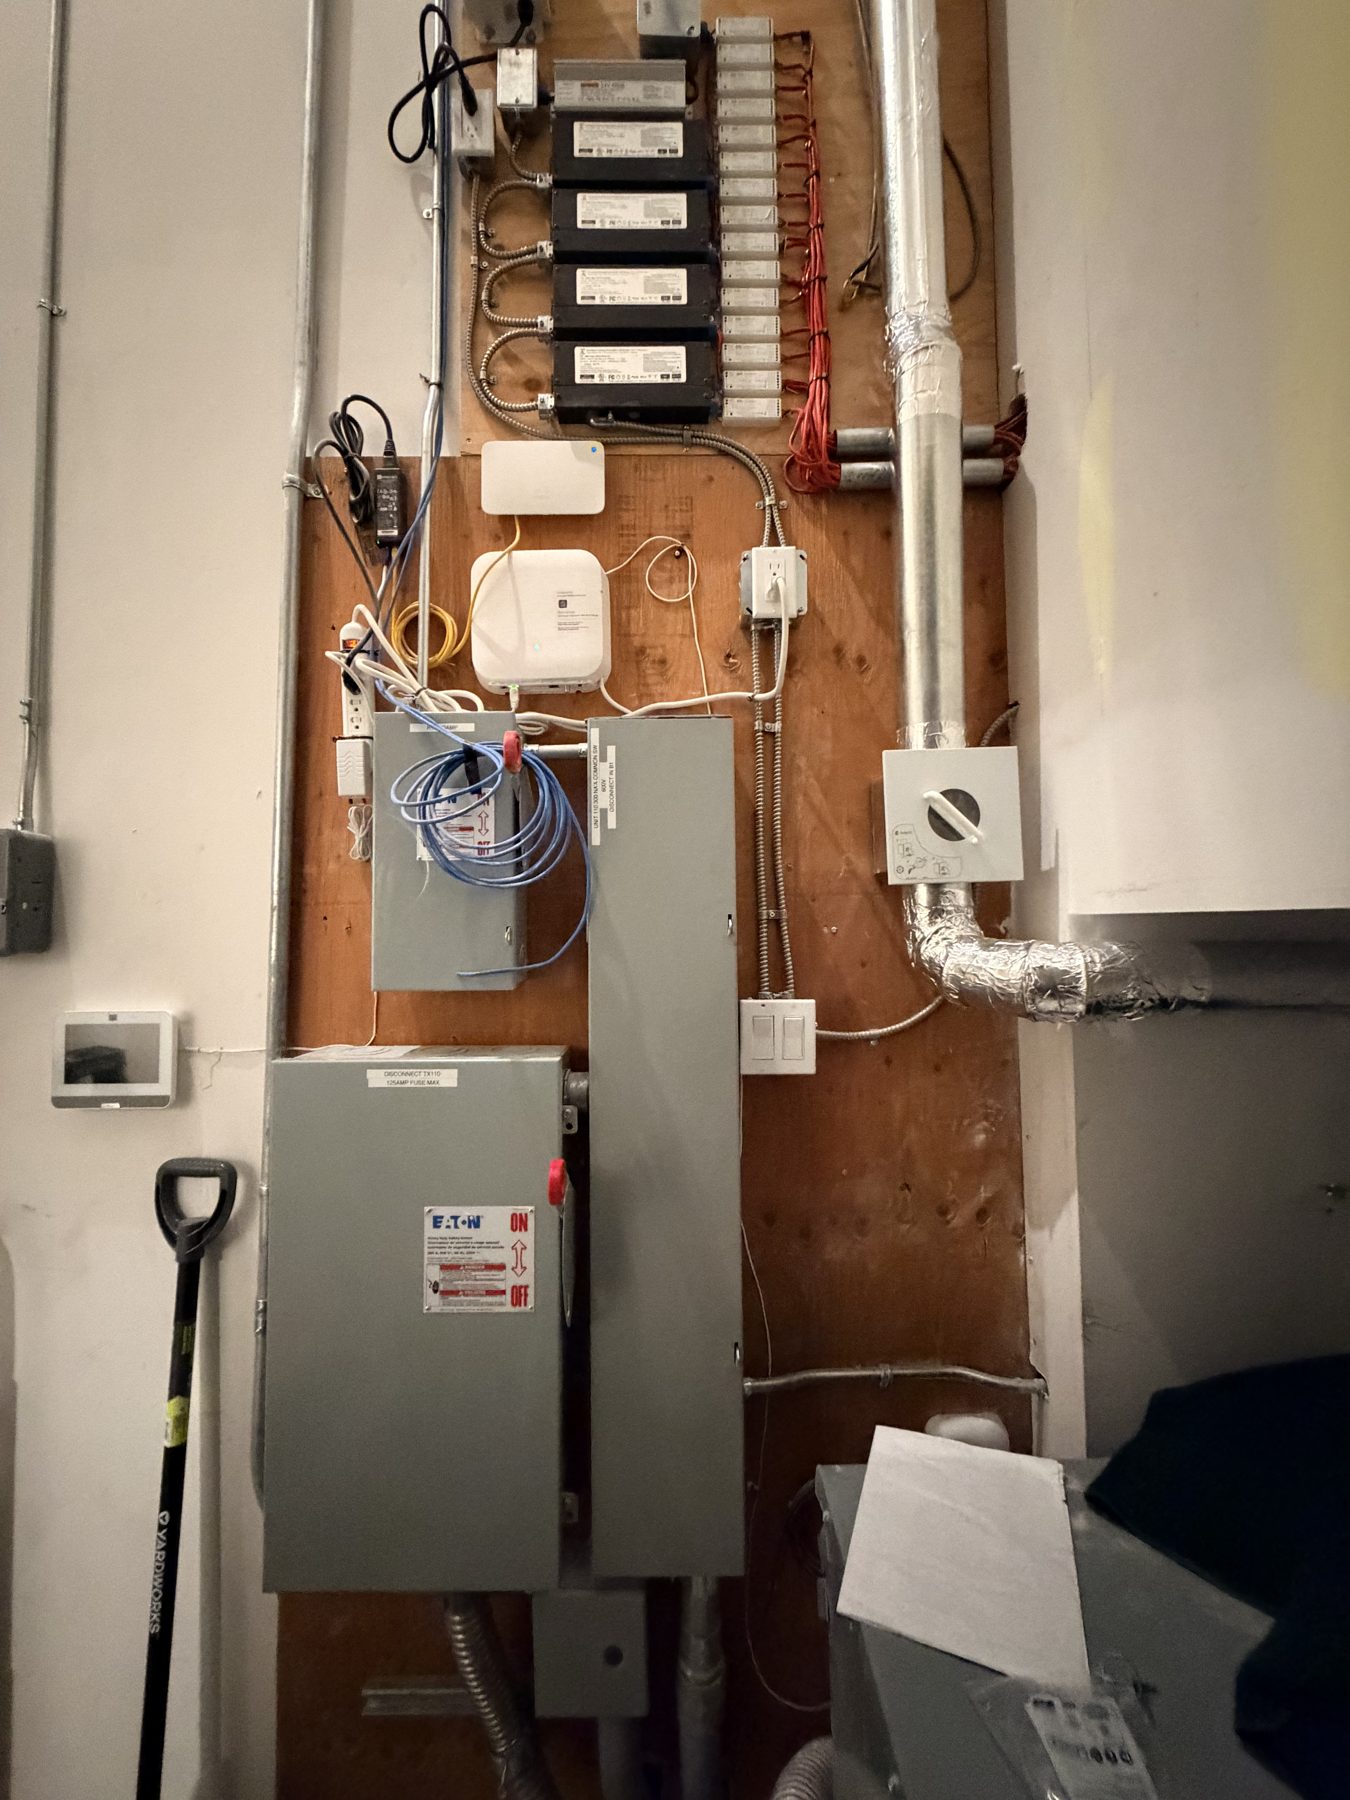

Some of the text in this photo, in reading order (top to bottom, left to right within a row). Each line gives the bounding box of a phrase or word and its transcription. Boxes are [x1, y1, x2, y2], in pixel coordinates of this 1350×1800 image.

[593, 745, 598, 754] SW
[432, 1215, 481, 1229] EATON
[510, 1212, 528, 1232] ON
[510, 1284, 529, 1307] OFF
[150, 1527, 168, 1634] YARDWORKS
